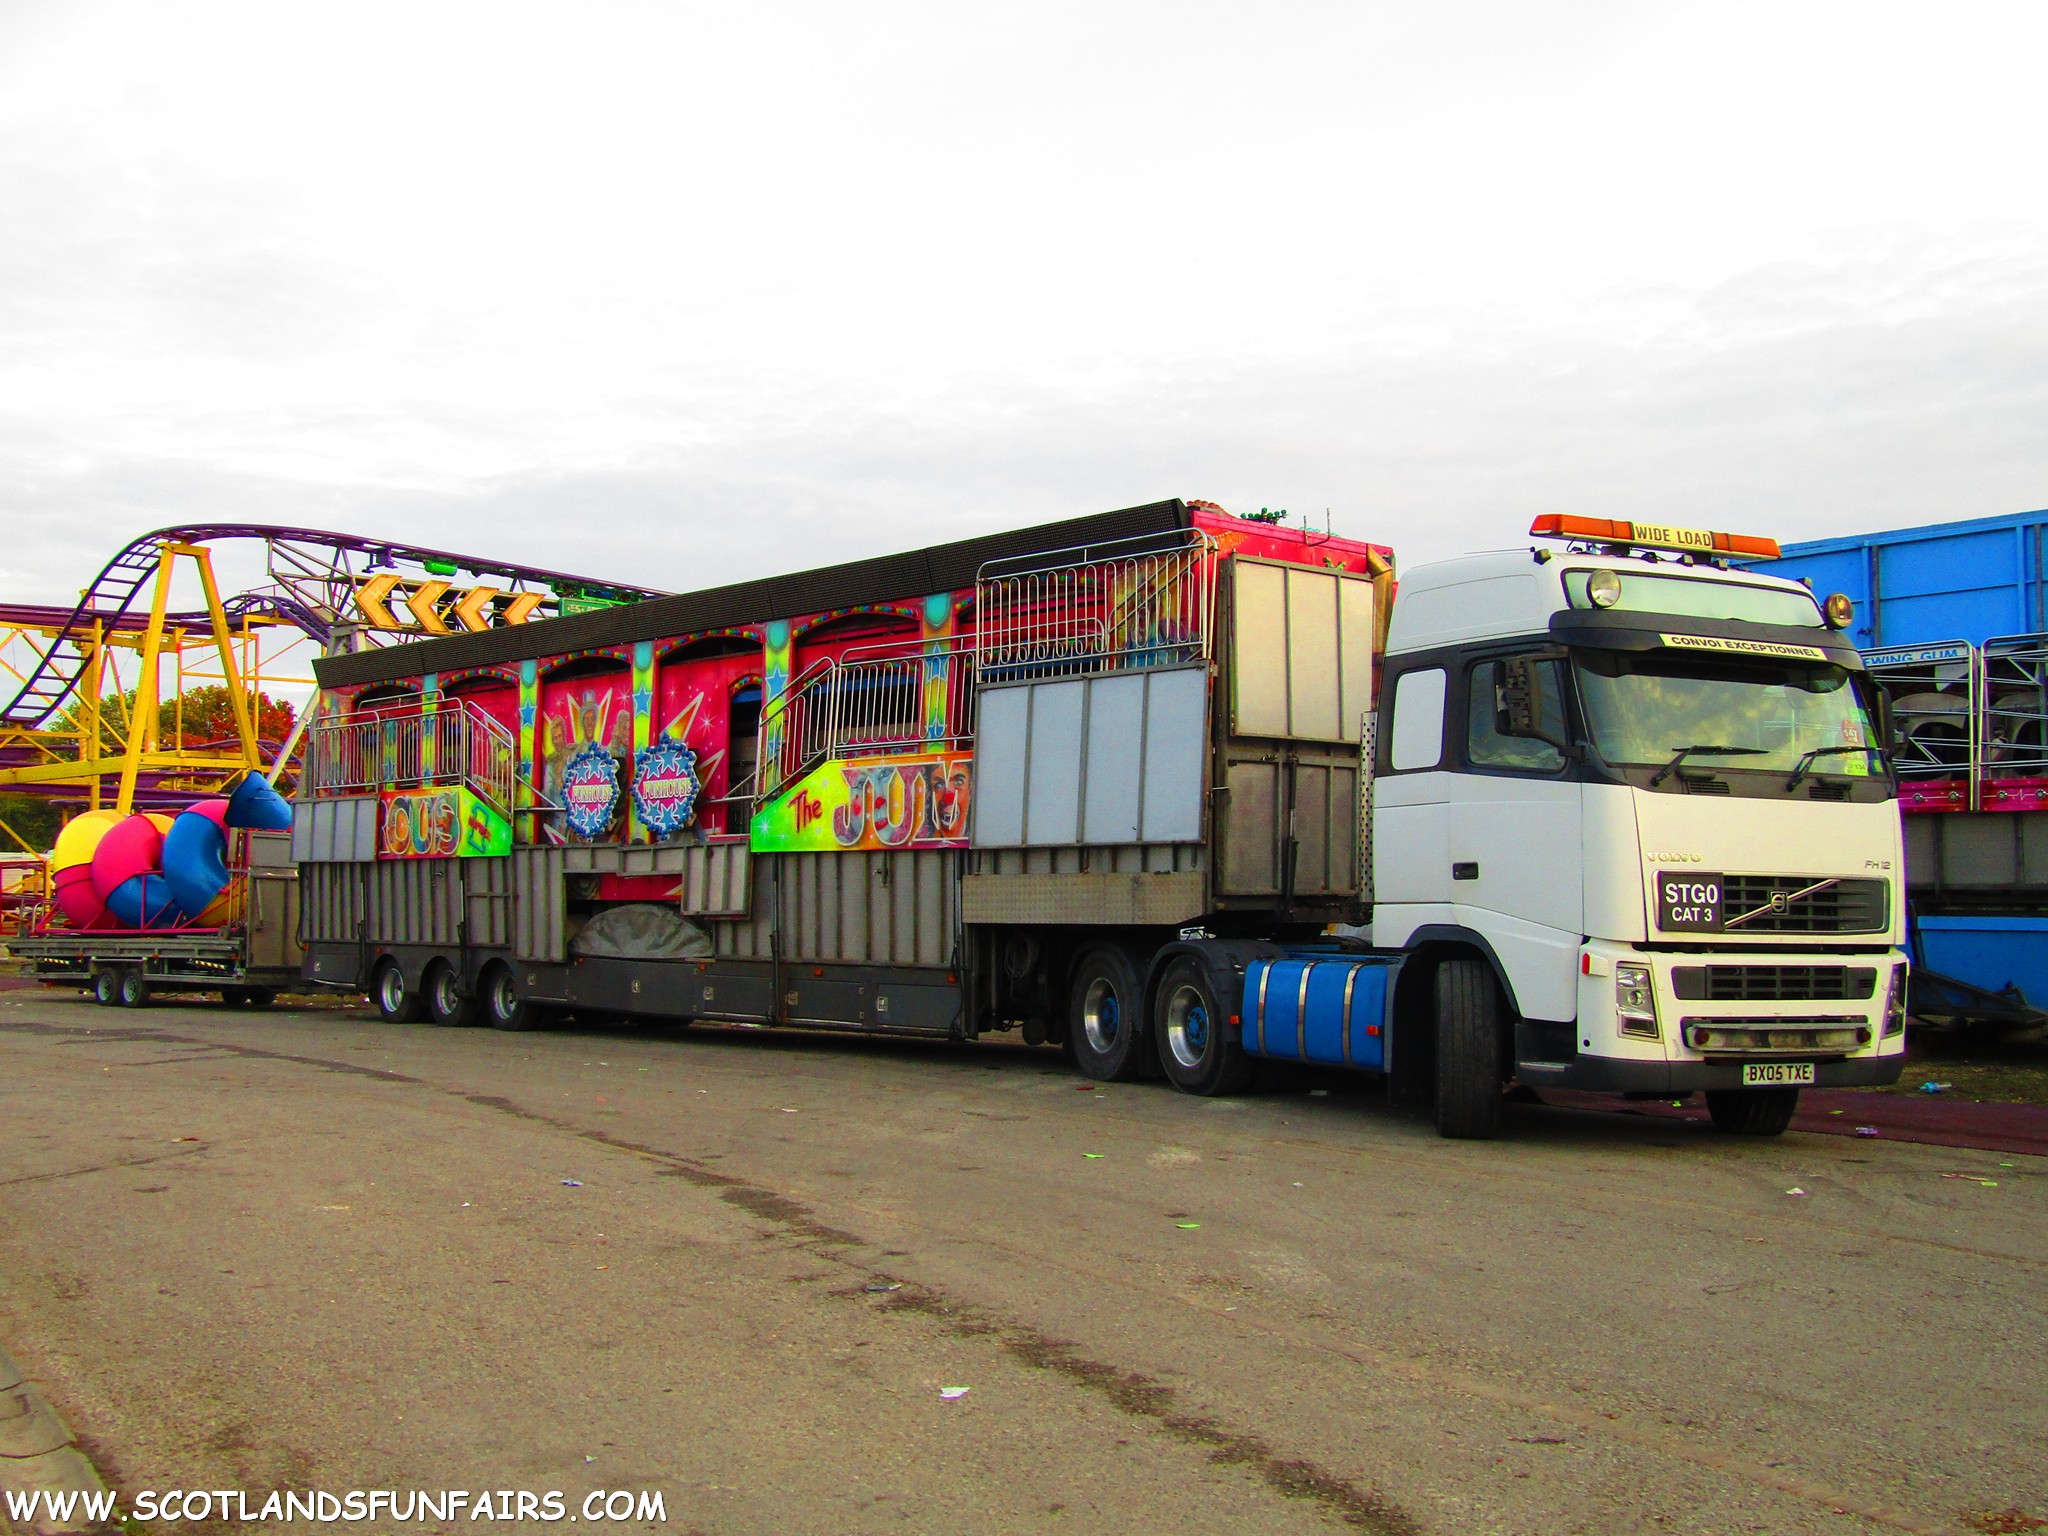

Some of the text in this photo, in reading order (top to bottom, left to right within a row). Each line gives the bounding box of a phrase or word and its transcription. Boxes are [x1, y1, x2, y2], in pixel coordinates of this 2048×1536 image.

[1635, 525, 1712, 548] WIDE LOAD
[1671, 636, 1820, 658] CONVOI EXCEPTIONNEL
[1863, 649, 1958, 665] EWING GUM
[571, 784, 613, 804] FUNHOUSE
[642, 777, 693, 800] FUNHOUSE
[787, 788, 823, 833] The
[1646, 852, 1702, 863] VOLVO
[1671, 907, 1713, 922] CAT 3
[1749, 1065, 1810, 1081] BX05 TXE
